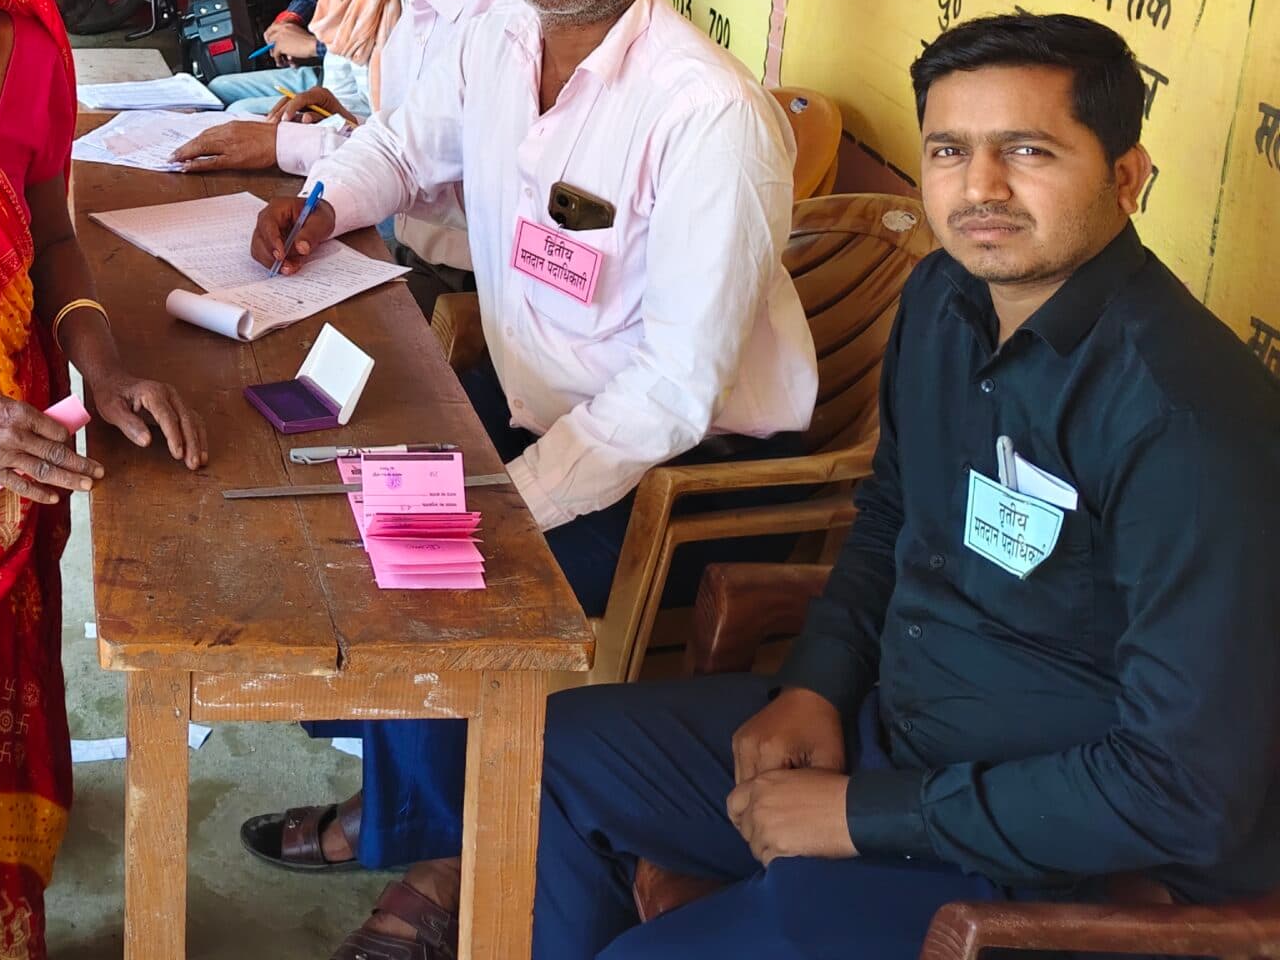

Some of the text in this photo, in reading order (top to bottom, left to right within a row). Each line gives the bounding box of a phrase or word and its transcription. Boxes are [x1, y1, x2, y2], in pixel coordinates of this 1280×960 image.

[709, 7, 731, 50] 700
[543, 235, 574, 263] द्वितीय
[520, 248, 588, 291] मतदान पदाधिकारी
[974, 516, 999, 547] मतदान
[998, 502, 1029, 531] तृतीय
